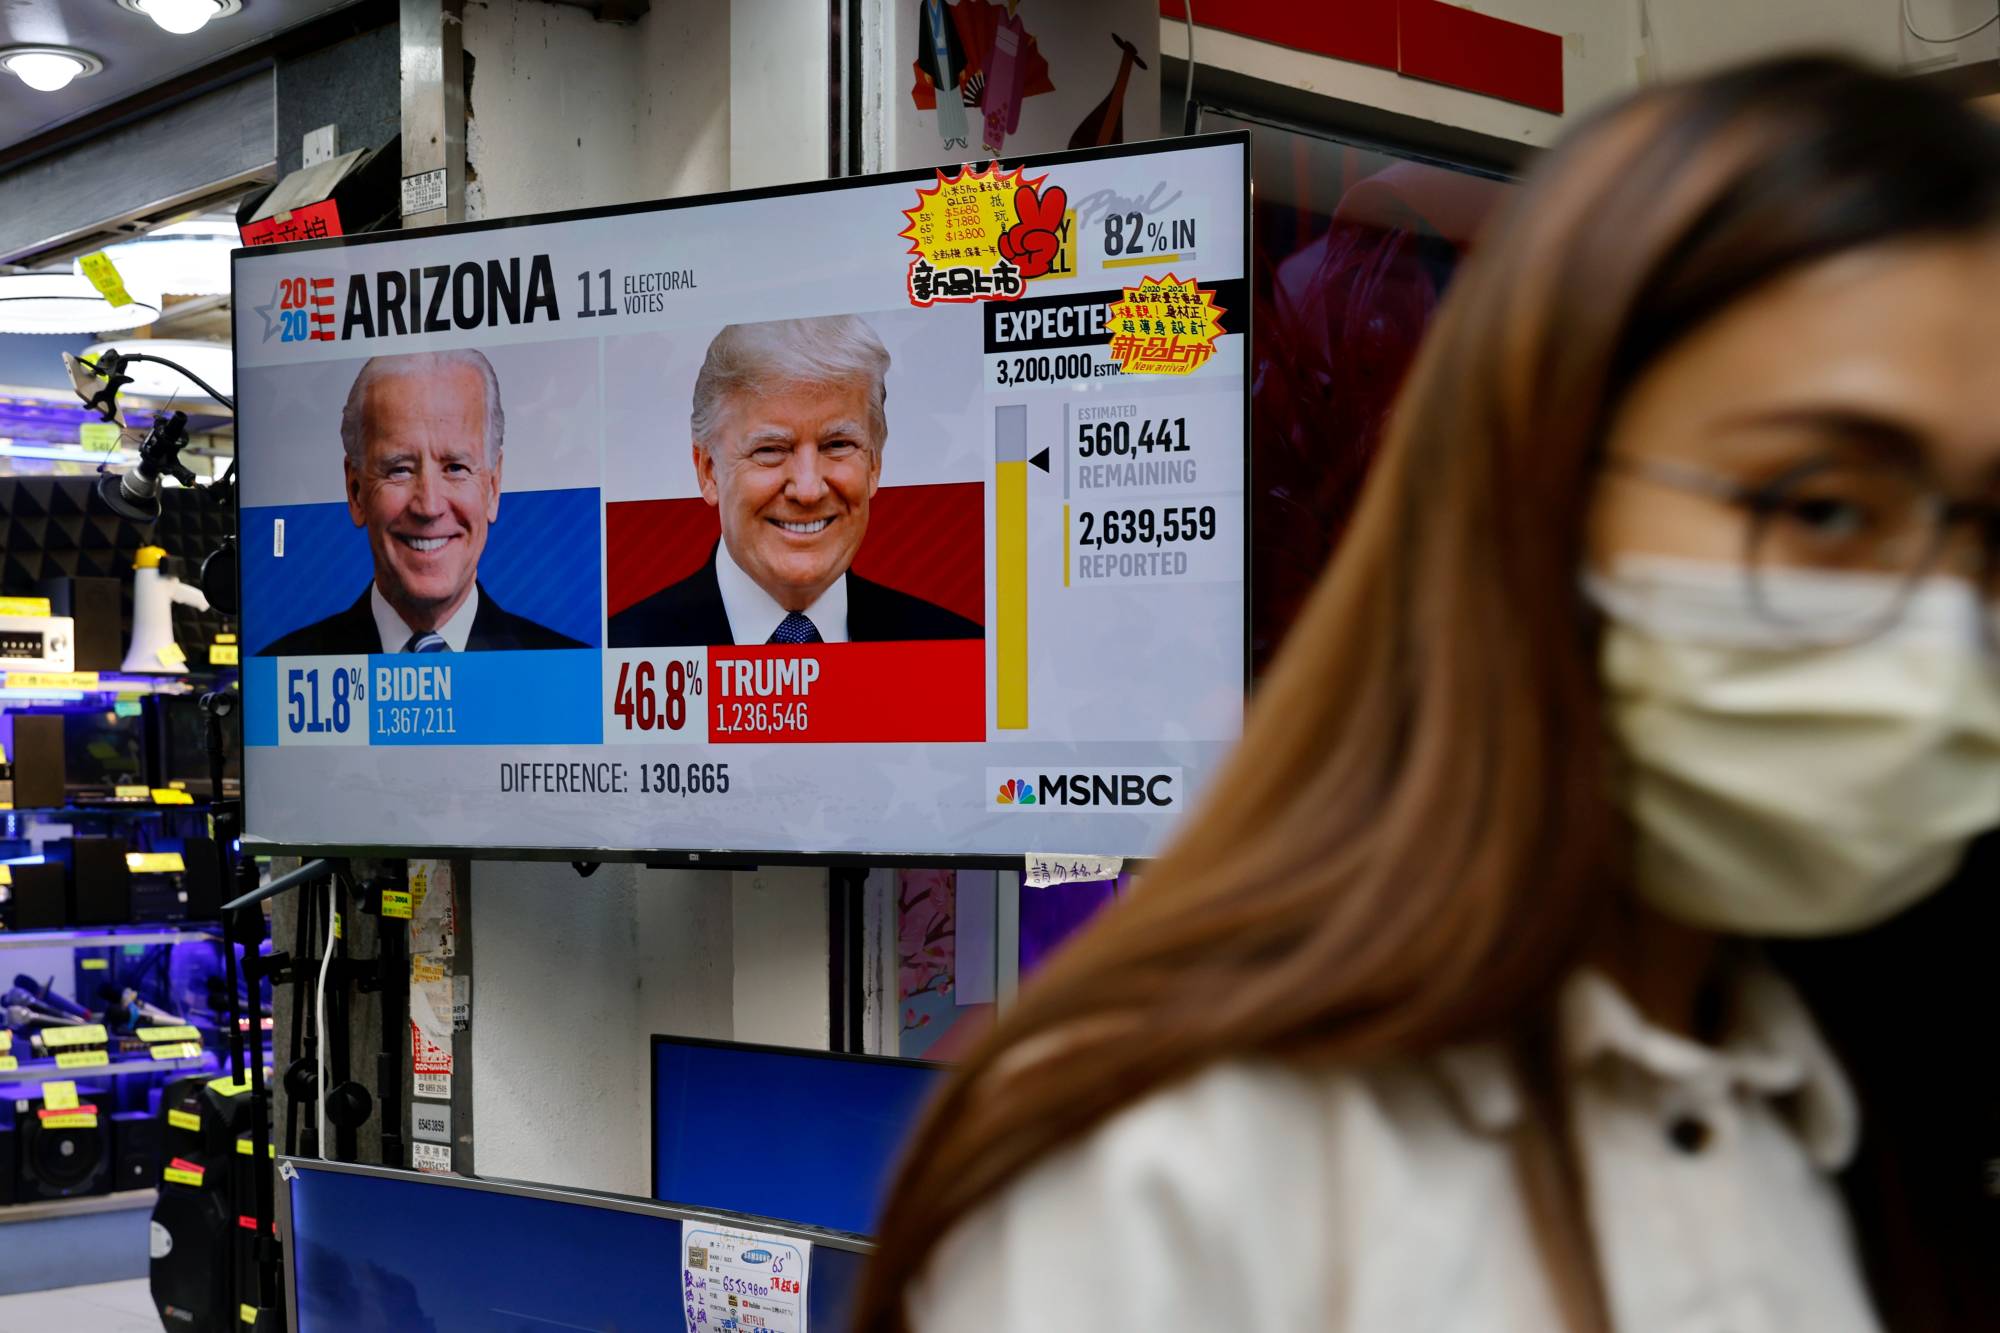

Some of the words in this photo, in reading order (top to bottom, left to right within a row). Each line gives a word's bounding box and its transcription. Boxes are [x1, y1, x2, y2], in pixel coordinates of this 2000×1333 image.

[947, 195, 977, 206] QLED
[1172, 218, 1196, 250] IN
[279, 277, 307, 309] 20
[577, 268, 618, 318] 11
[624, 269, 697, 294] ELECTORAL
[913, 260, 1020, 300] 新品上市
[341, 254, 560, 340] ARIZONA
[624, 293, 664, 315] VOTES
[280, 310, 308, 342] 20
[1111, 334, 1212, 369] 新品上市
[1133, 361, 1153, 371] New
[1154, 363, 1189, 374] arrival
[997, 353, 1092, 387] 3,200,000
[1078, 404, 1137, 421] ESTIMATED
[1079, 417, 1191, 460] 560,441
[1079, 459, 1197, 489] REMAINING
[1079, 506, 1216, 550] 2,639,559
[1079, 551, 1188, 578] REPORTED
[376, 666, 452, 702] BIDEN
[716, 658, 820, 696] TRUMP
[288, 667, 365, 733] 51.8%
[614, 660, 702, 730] 46.8%
[376, 707, 456, 736] 1,367,211
[716, 702, 809, 734] 1,236,546
[500, 763, 628, 793] DIFFERENCE:
[640, 763, 730, 798] 130,665
[1039, 774, 1173, 806] MSNBC
